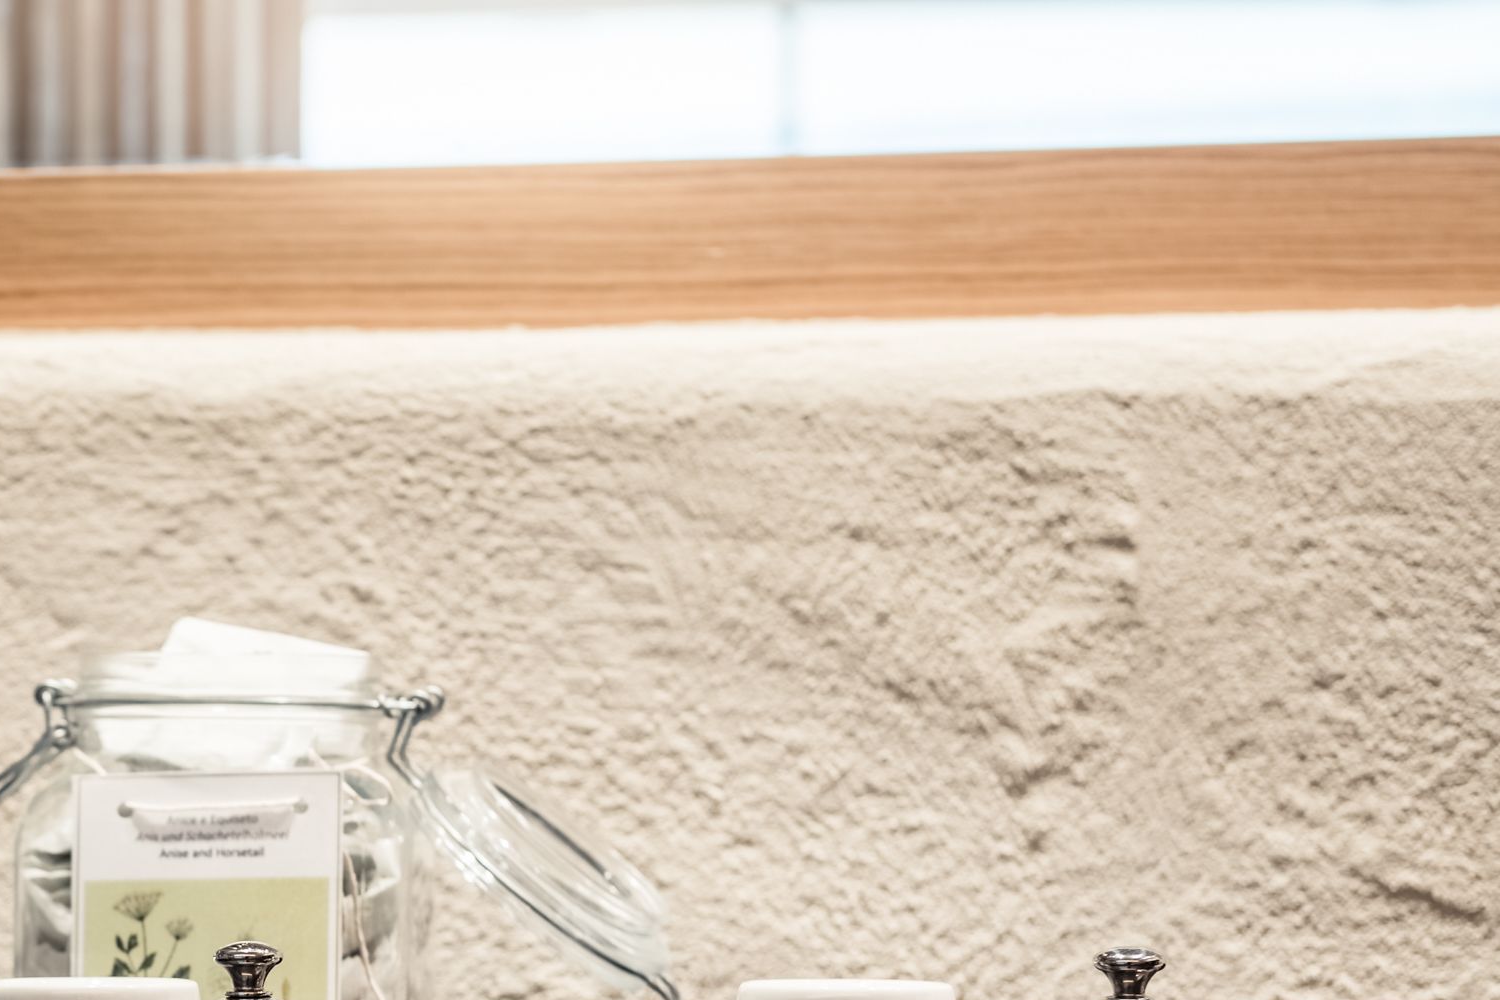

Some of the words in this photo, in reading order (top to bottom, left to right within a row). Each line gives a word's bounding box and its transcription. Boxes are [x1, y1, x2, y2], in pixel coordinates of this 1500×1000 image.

[159, 848, 189, 859] Anise
[192, 848, 212, 858] and
[216, 846, 265, 858] Horsetail
